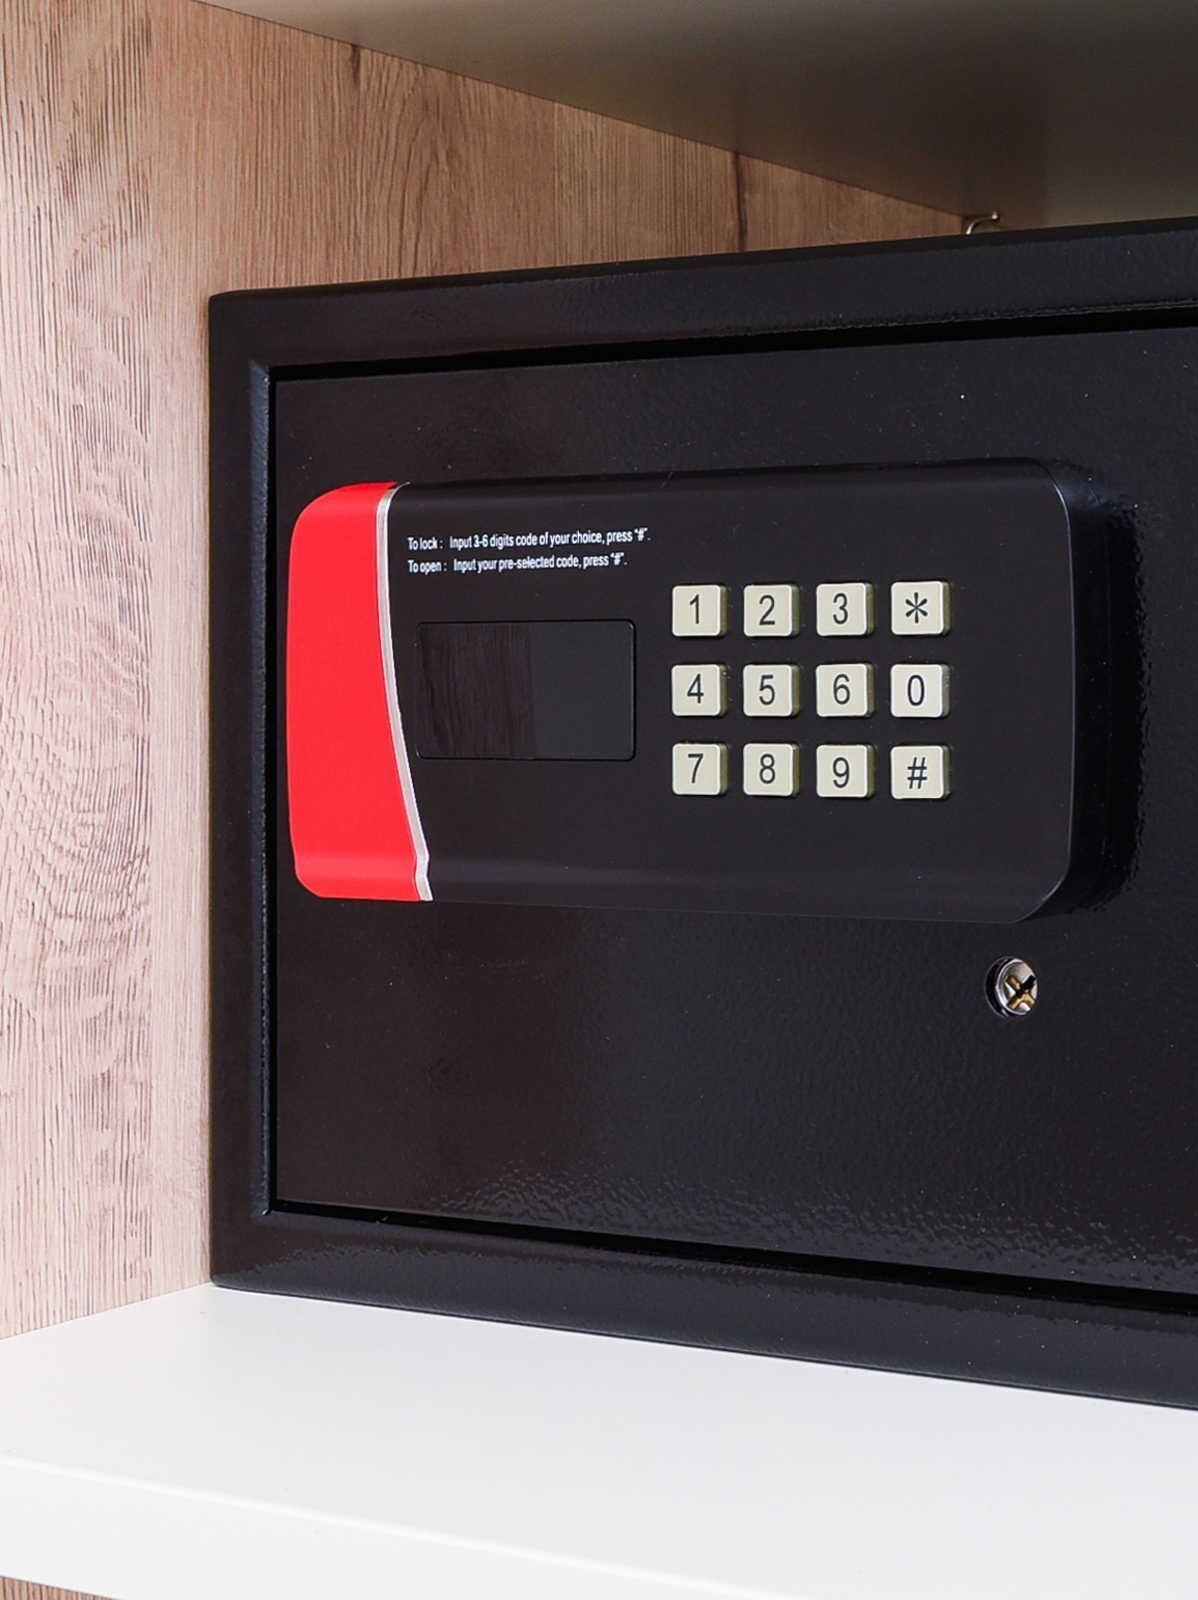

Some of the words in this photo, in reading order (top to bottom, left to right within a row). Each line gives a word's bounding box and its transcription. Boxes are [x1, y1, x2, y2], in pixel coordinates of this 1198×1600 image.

[407, 536, 419, 550] To
[449, 535, 472, 551] Input
[473, 534, 489, 548] 3-6
[489, 532, 514, 550] digits
[515, 532, 538, 547] code
[539, 531, 549, 546] of
[549, 533, 571, 548] your
[571, 530, 605, 545] choice,
[606, 530, 633, 546] press
[407, 560, 419, 573] To
[453, 558, 477, 574] Input
[477, 559, 497, 574] your
[498, 555, 555, 573] pre-selected
[556, 554, 582, 569] code,
[583, 555, 609, 570] press
[689, 594, 700, 625] 1
[758, 594, 776, 626] 2
[832, 592, 849, 625] 3
[686, 673, 705, 704] 4
[758, 674, 776, 706] 5
[832, 673, 851, 705] 6
[906, 674, 925, 707] 0
[687, 753, 704, 784] 7
[758, 753, 777, 785] 8
[832, 756, 851, 789] 9
[906, 756, 928, 789] #
